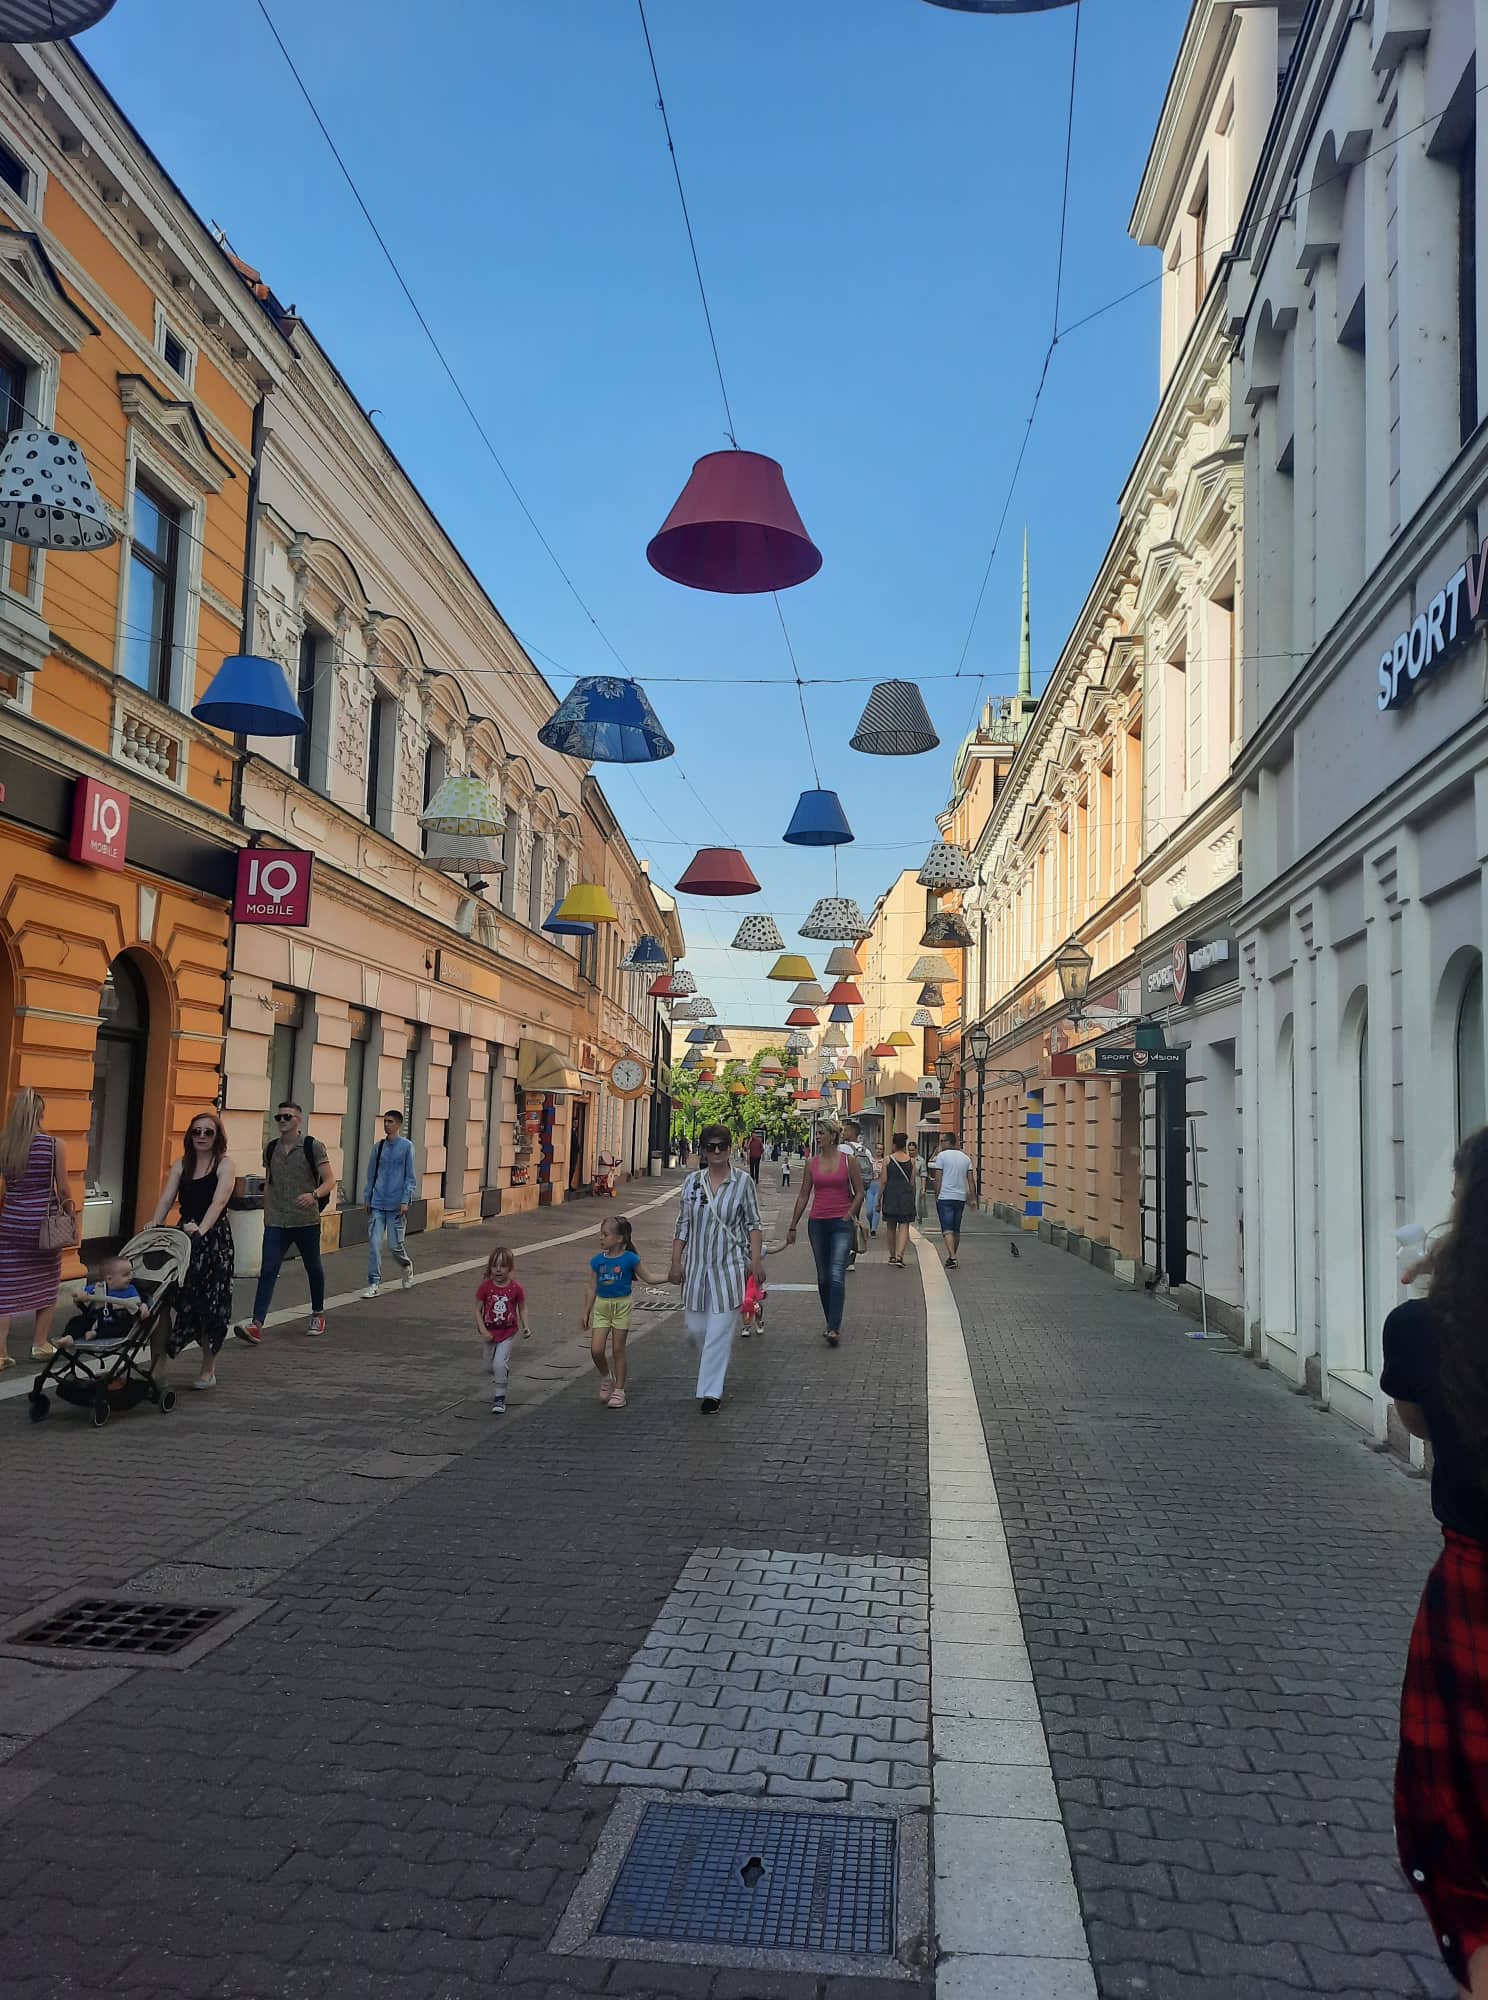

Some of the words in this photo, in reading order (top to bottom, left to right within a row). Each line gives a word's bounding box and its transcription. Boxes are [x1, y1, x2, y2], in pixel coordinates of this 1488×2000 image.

[92, 793, 121, 844] IQ
[90, 840, 119, 858] MOBILE
[248, 859, 297, 904] IQ
[246, 903, 295, 916] MOBILE
[1150, 1052, 1179, 1061] VISION
